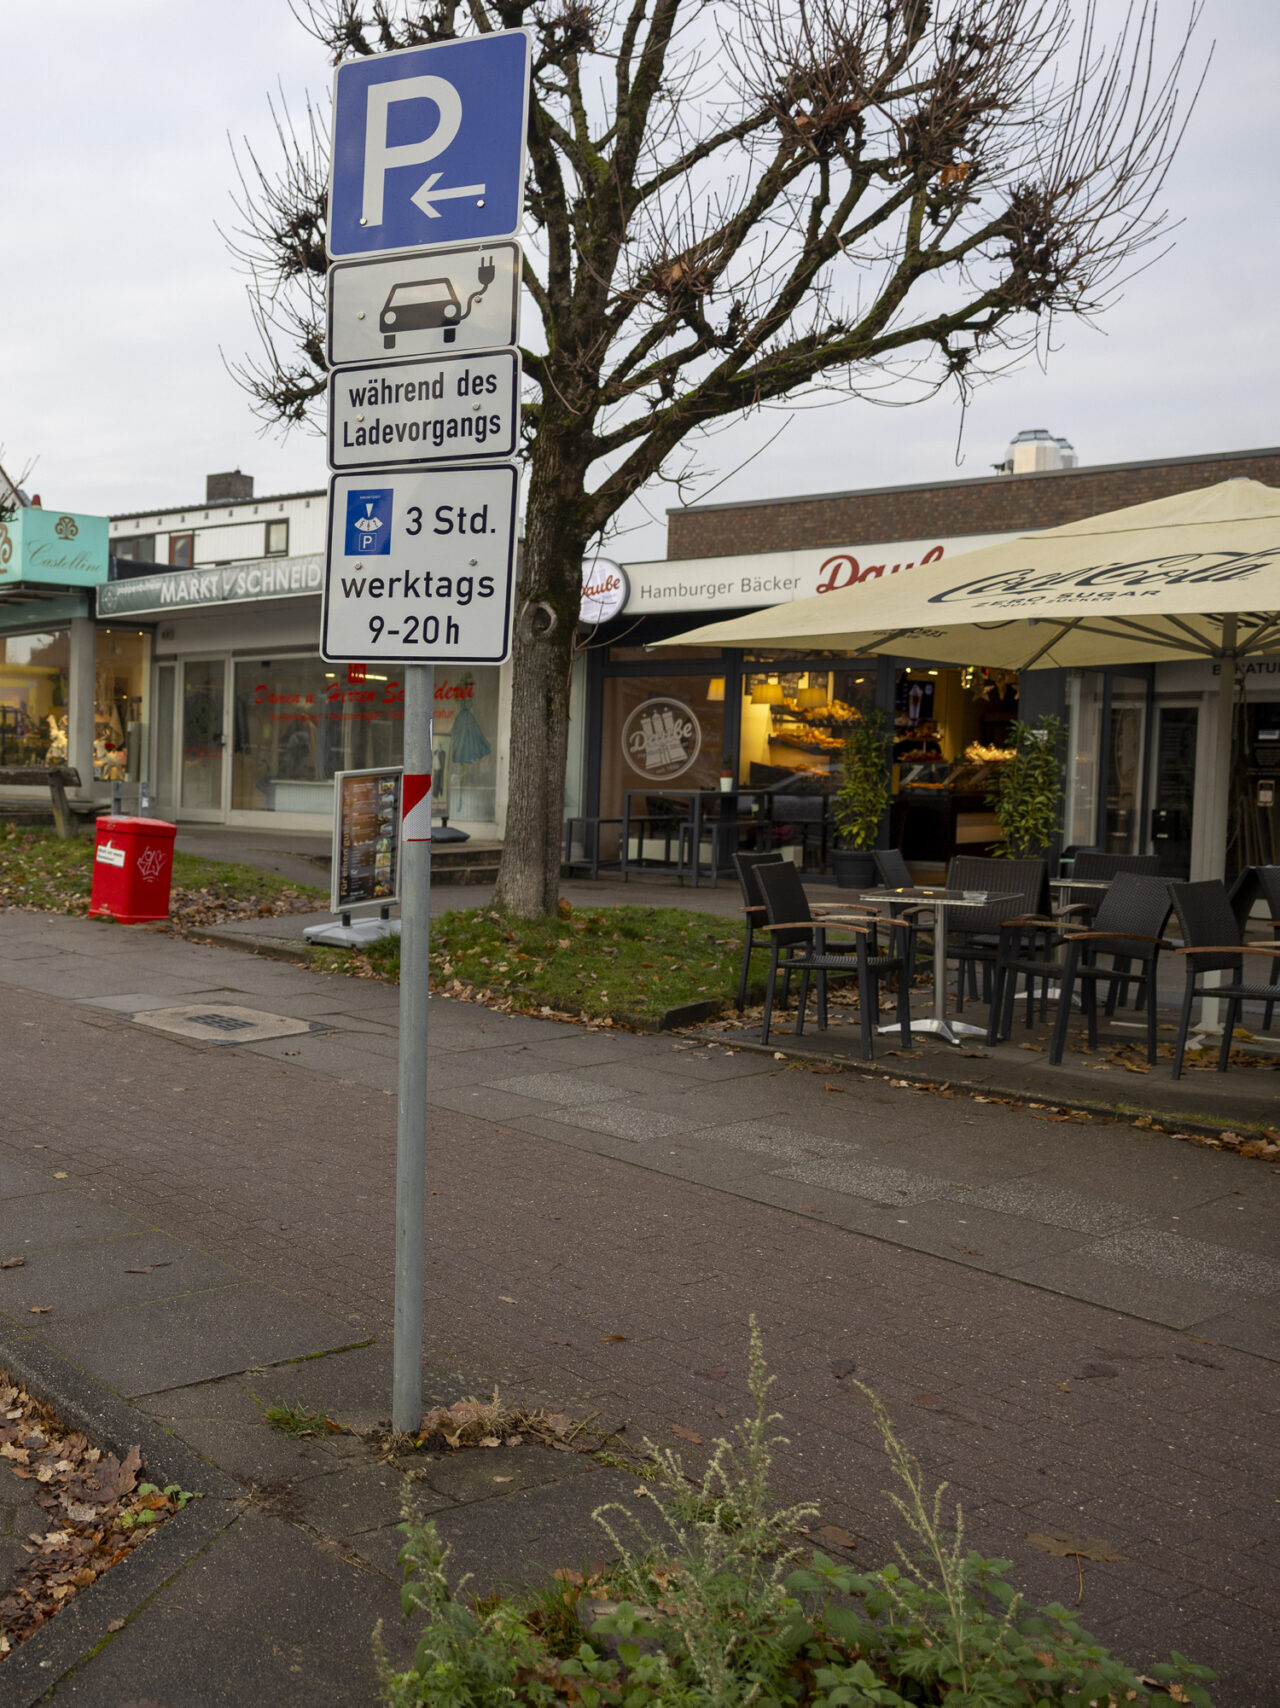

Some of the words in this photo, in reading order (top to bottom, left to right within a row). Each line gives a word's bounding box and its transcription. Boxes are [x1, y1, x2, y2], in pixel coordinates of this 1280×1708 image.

[361, 75, 463, 228] P
[349, 372, 445, 408] während
[457, 369, 497, 397] des
[343, 414, 501, 447] Ladevorgangs
[406, 506, 423, 535] 3
[433, 504, 496, 535] Std.
[160, 574, 219, 604] MARKT
[236, 564, 322, 595] SCHNEID
[341, 570, 495, 606] werktags
[640, 581, 734, 599] Hamburger
[740, 576, 802, 593] Bäcker
[928, 547, 1280, 603] Coca-Cola
[972, 595, 1046, 609] ZERO
[1056, 590, 1162, 600] SUGAR
[254, 684, 300, 705] Damen
[305, 693, 318, 704] u.
[326, 682, 376, 704] Herren
[629, 718, 693, 753] Daube
